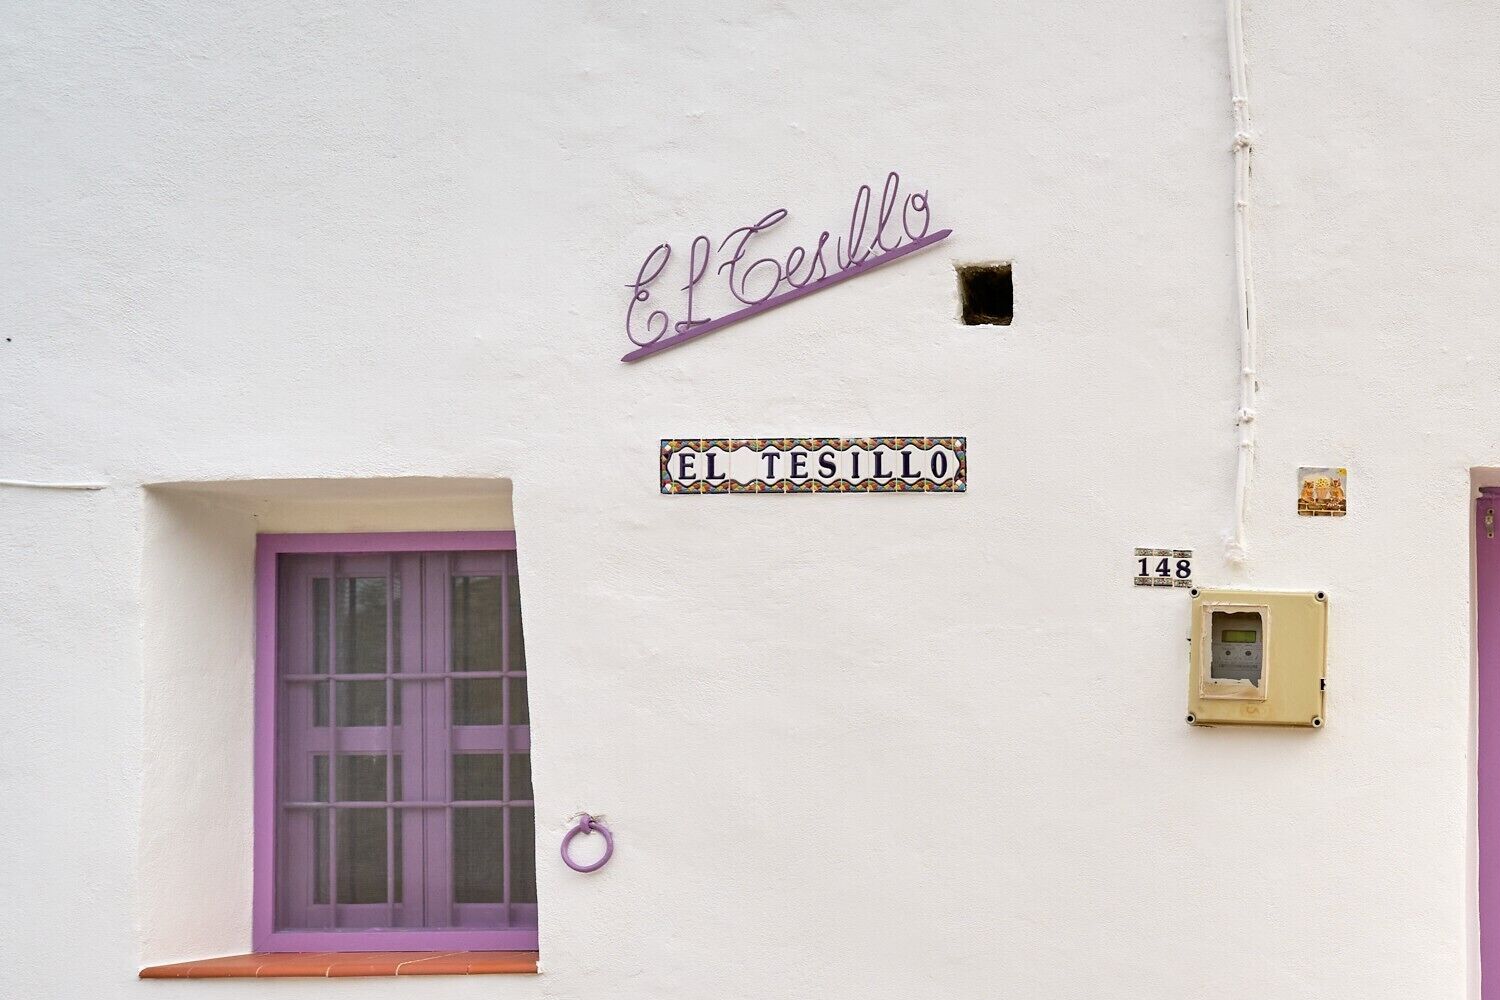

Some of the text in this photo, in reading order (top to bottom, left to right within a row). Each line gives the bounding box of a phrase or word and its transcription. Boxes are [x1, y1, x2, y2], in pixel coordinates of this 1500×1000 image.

[717, 171, 931, 305] Tesillo
[677, 451, 948, 480] EL TESILLO
[1137, 557, 1192, 579] 148
